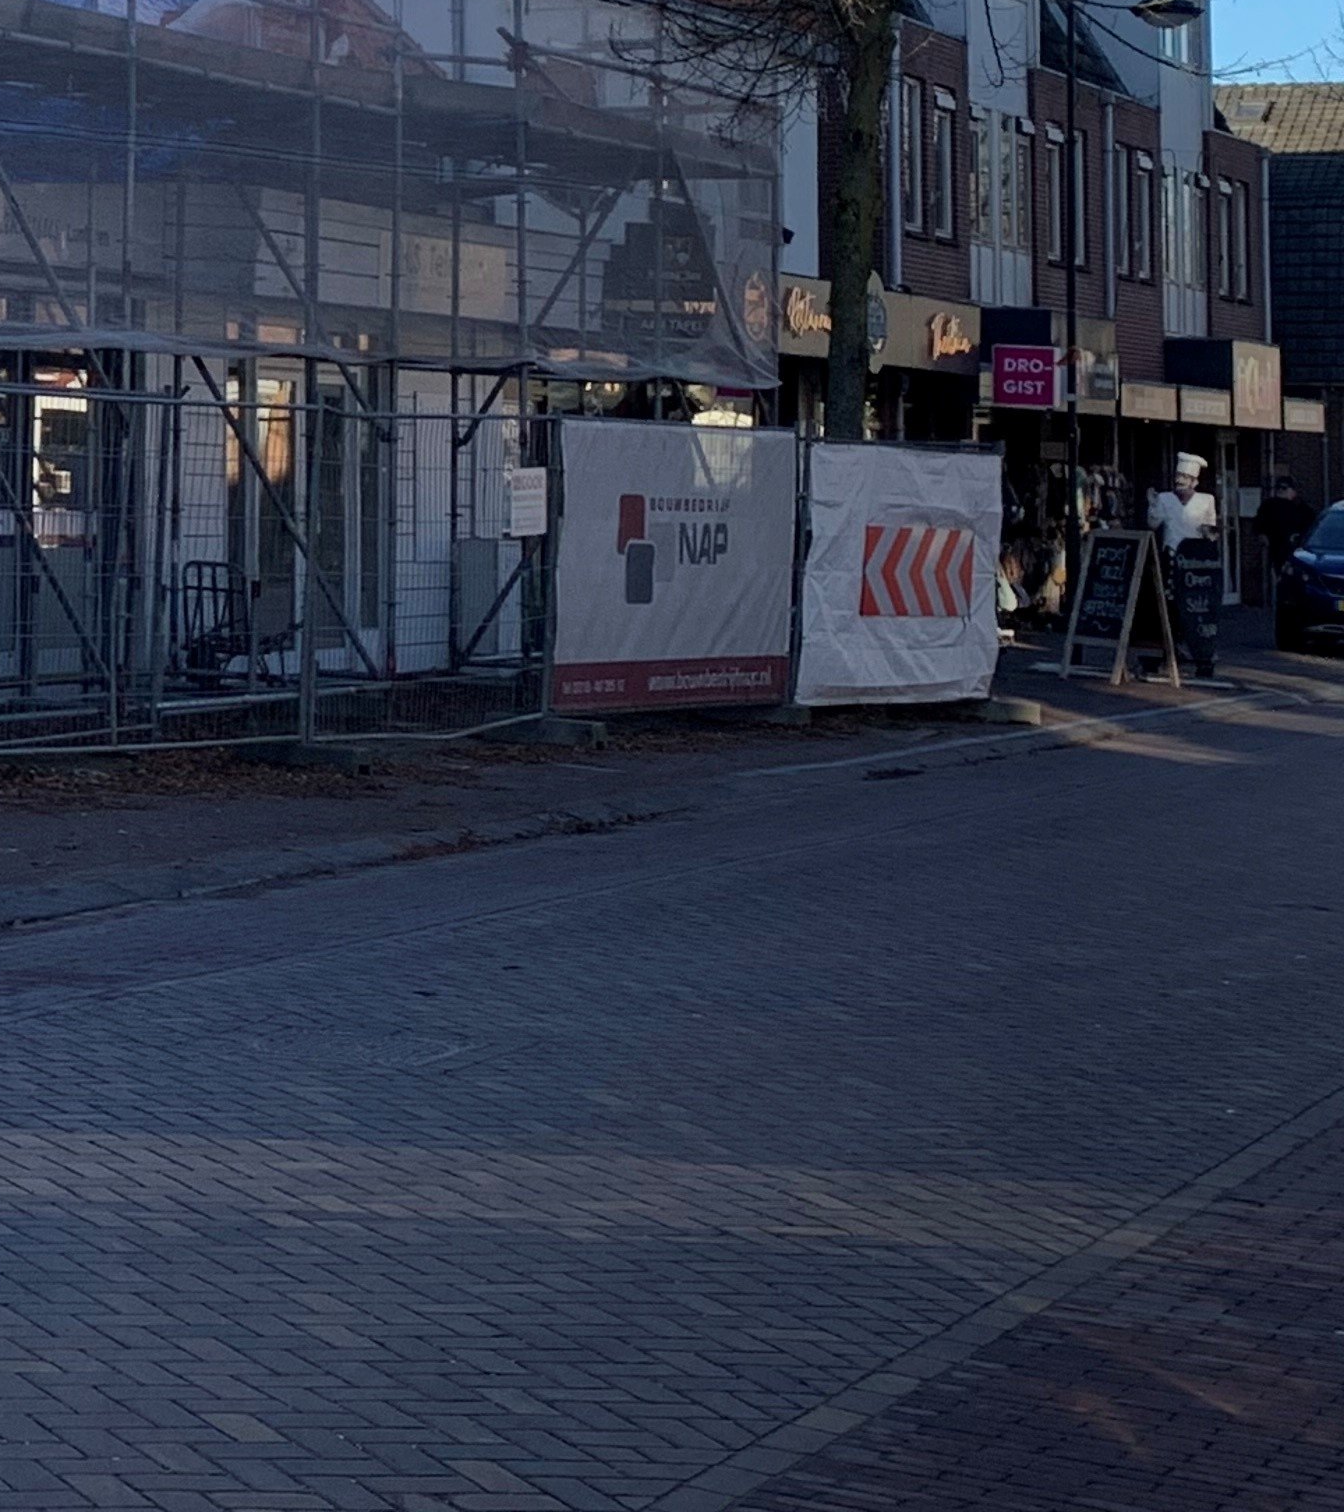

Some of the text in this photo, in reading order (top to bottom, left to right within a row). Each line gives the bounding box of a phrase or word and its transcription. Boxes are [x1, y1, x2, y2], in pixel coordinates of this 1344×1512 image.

[1003, 357, 1053, 374] DRO-
[1003, 379, 1046, 396] GIST
[649, 496, 731, 513] BOUWBEDRIJF
[679, 522, 729, 565] NAP
